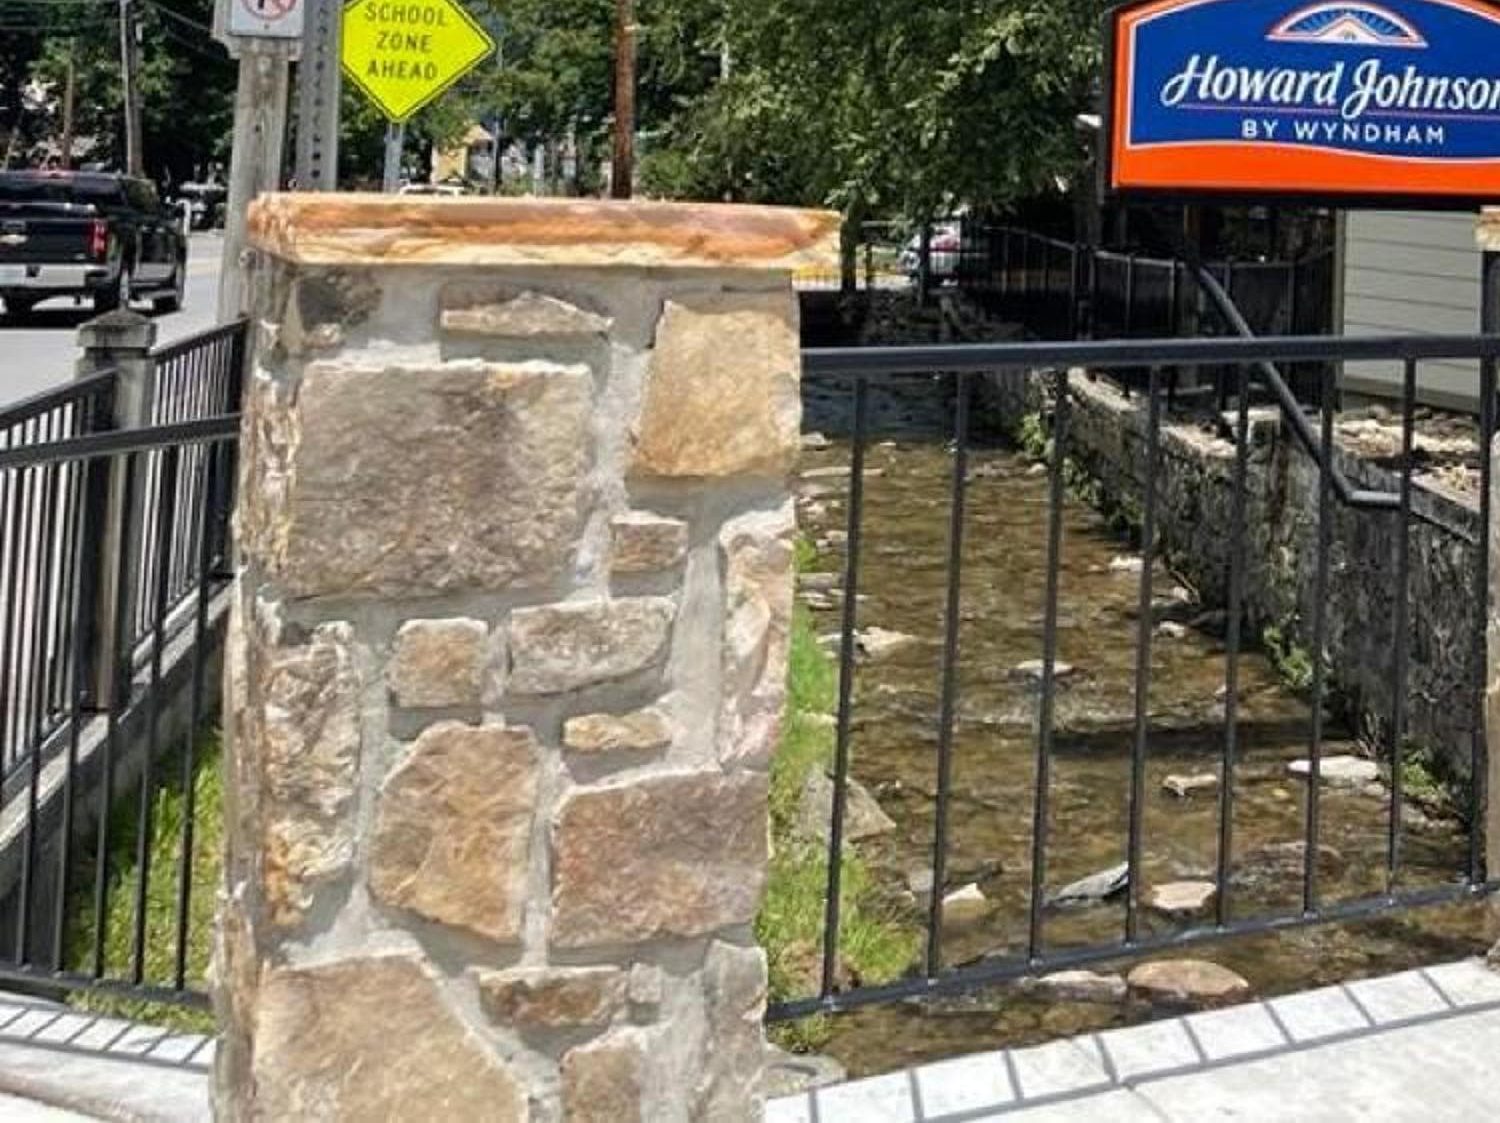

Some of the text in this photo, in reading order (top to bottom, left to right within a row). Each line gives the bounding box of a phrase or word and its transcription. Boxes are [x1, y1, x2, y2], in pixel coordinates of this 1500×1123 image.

[365, 2, 448, 26] SCHOOL
[376, 32, 433, 53] ZONE
[367, 61, 438, 81] AHEAD
[1160, 54, 1344, 108] Howard
[1241, 120, 1445, 144] BY WYNDHAM
